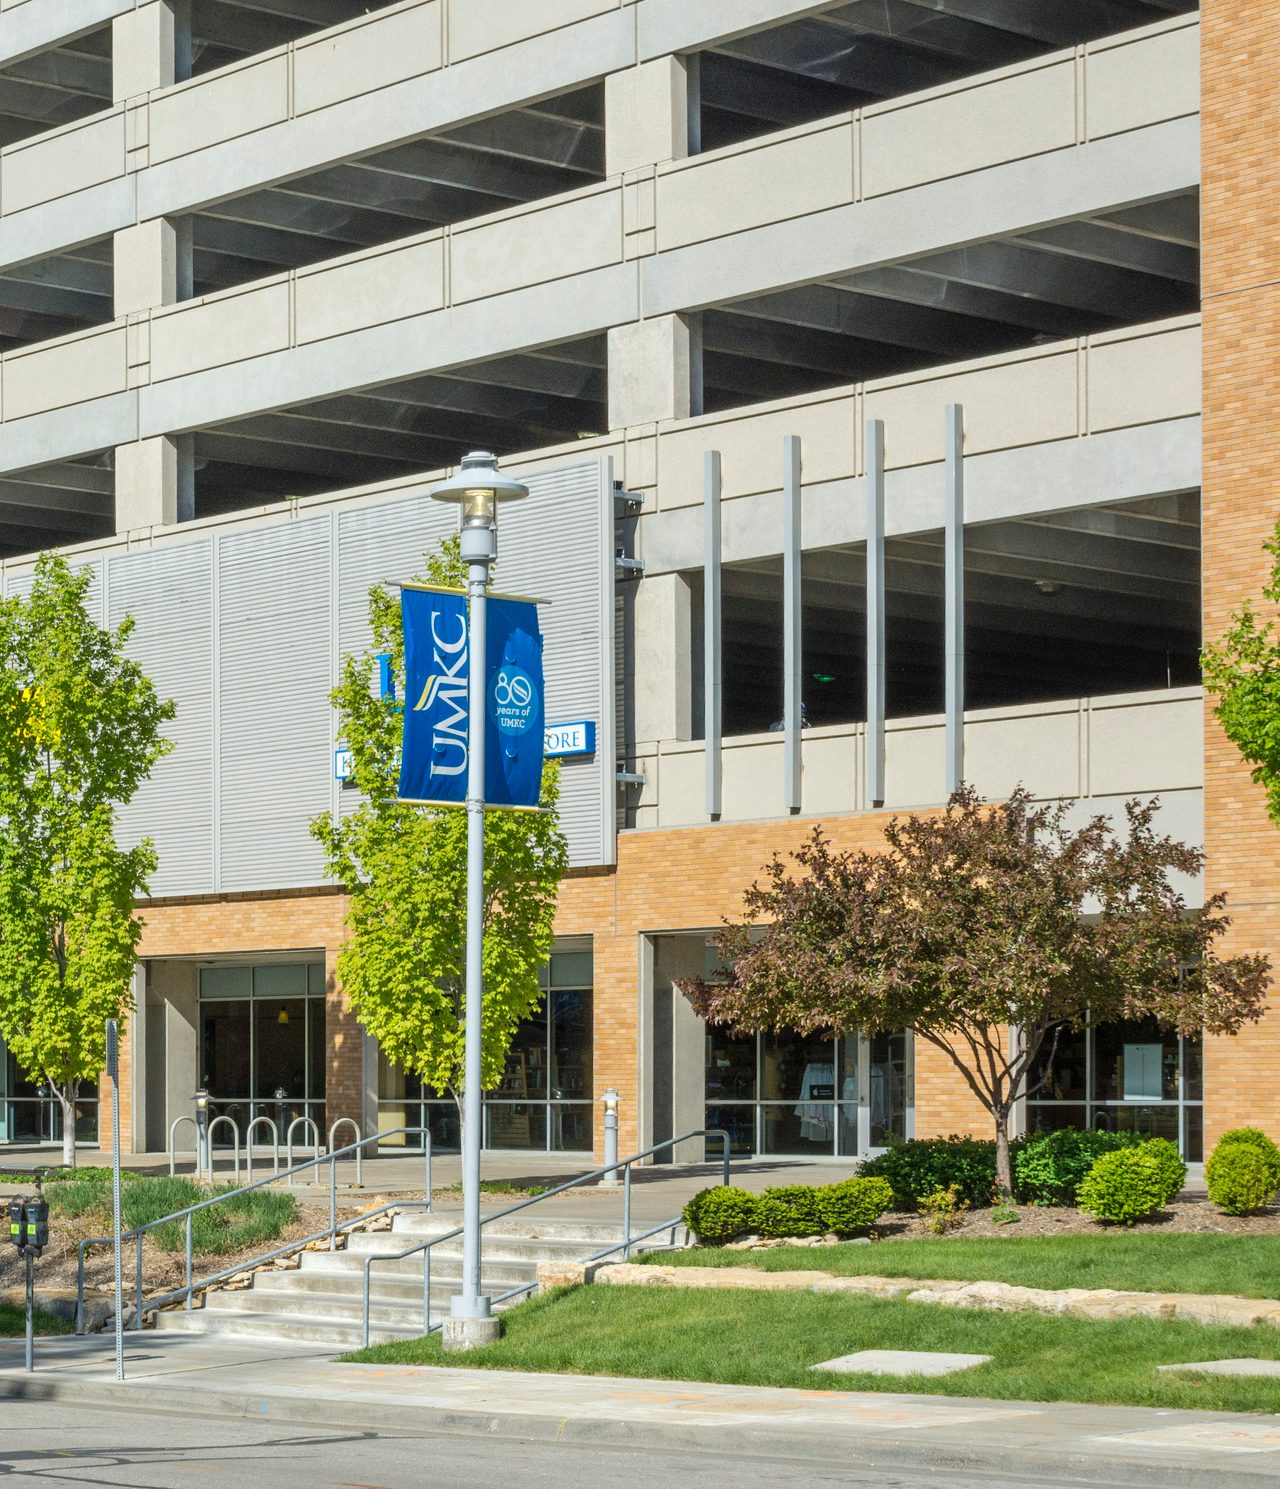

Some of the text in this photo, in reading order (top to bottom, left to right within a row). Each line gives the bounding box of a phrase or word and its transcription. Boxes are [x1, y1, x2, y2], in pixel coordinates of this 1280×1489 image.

[424, 611, 469, 779] UMKC
[494, 672, 532, 706] 80
[495, 705, 531, 717] years of
[500, 717, 526, 728] UMKC
[547, 731, 580, 750] ORE
